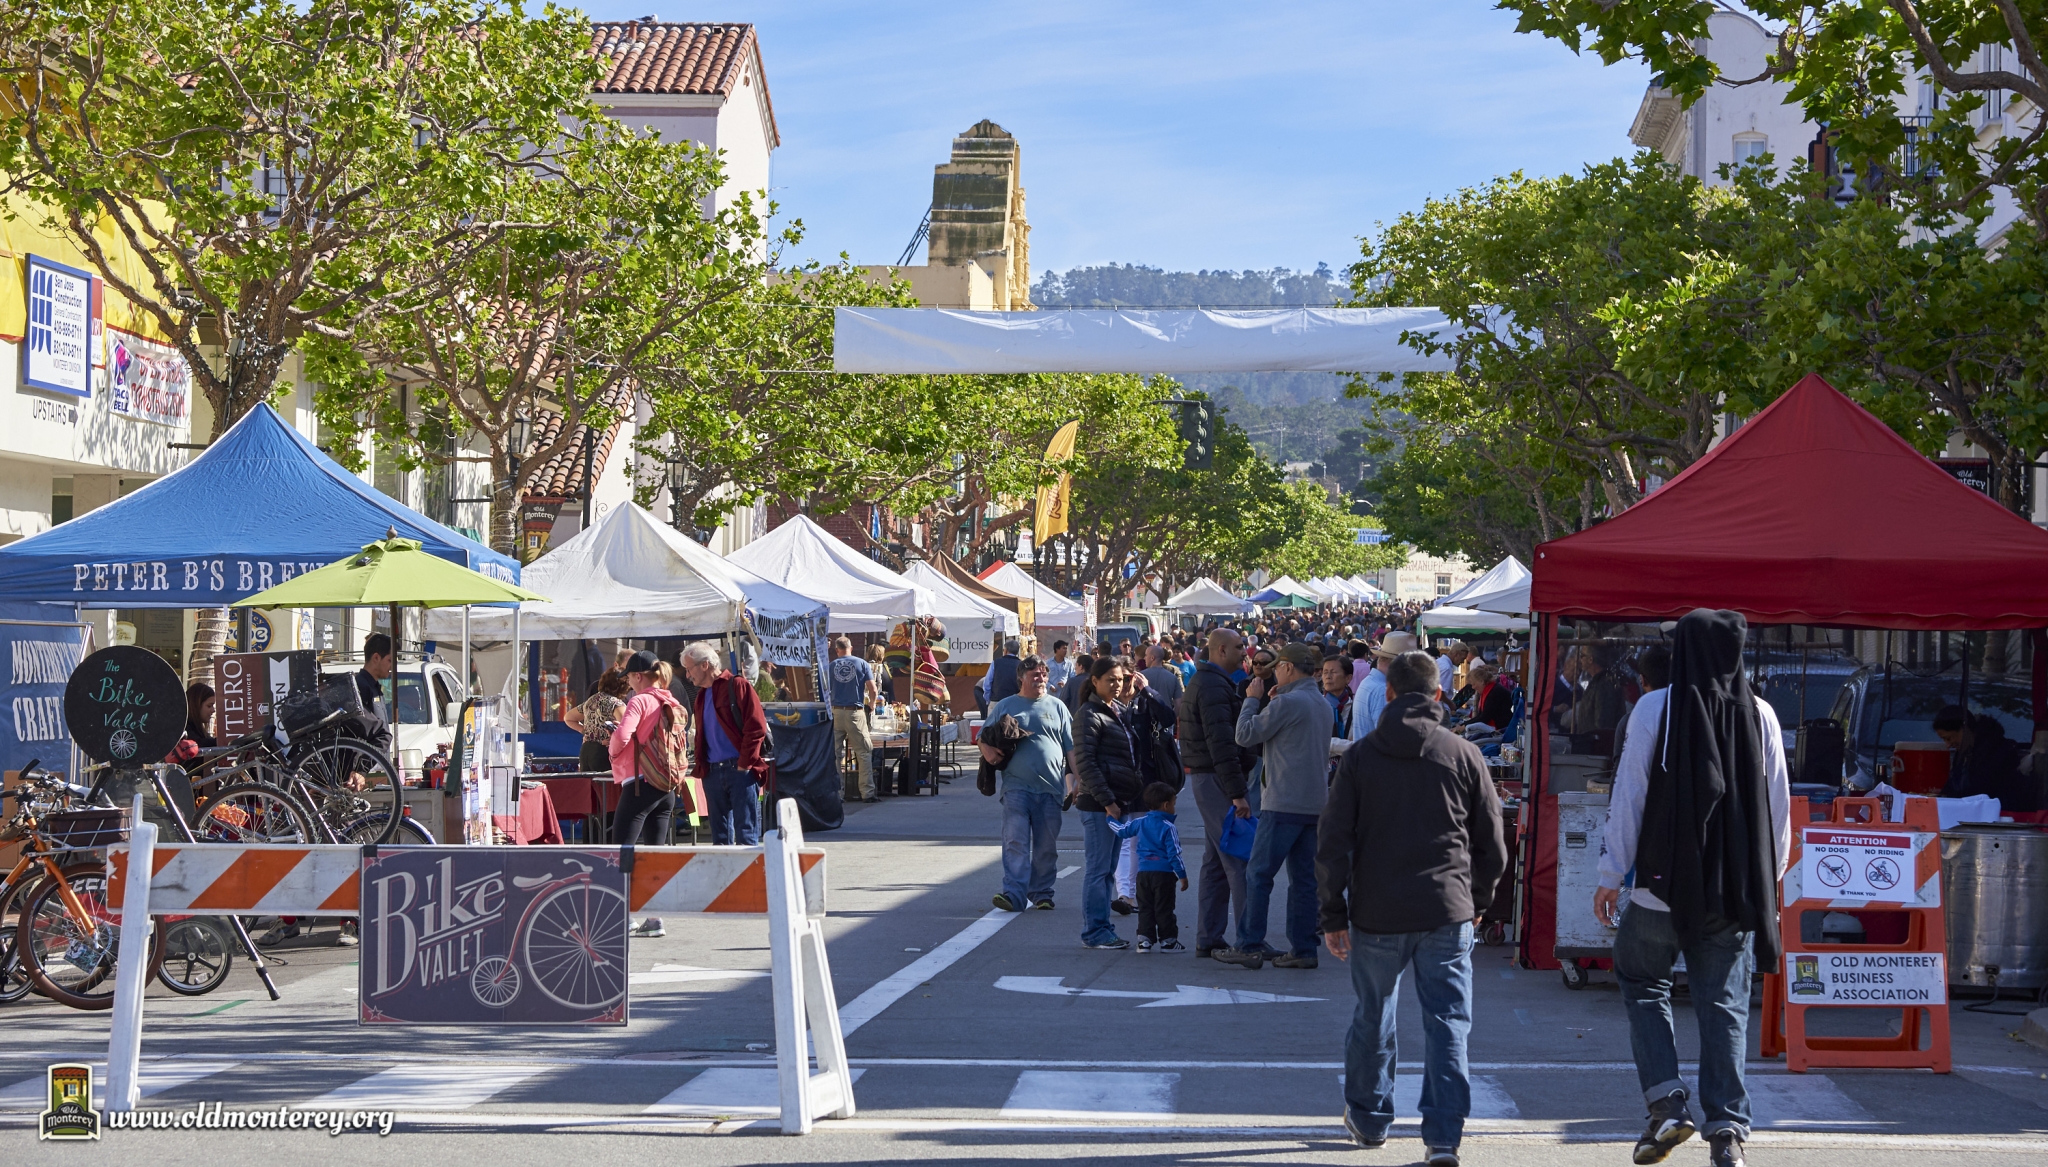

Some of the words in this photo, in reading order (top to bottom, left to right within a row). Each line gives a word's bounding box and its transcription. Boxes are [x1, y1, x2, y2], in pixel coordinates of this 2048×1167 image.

[54, 289, 82, 309] Construction
[113, 387, 130, 400] TACO
[130, 382, 186, 418] CONSTRUCTION
[32, 398, 67, 425] UPSTAIRS
[113, 401, 129, 413] BELL
[1956, 470, 1973, 478] Old
[524, 511, 555, 521] Monterey
[72, 561, 170, 592] PETER
[181, 560, 225, 592] B'S
[948, 637, 990, 654] ldpress
[104, 659, 120, 672] The
[88, 676, 151, 708] Bike
[12, 696, 64, 742] CRAFT
[104, 708, 150, 734] Valet
[1829, 835, 1887, 846] ATTENTION
[1828, 846, 1850, 854] DOGS
[370, 856, 507, 997] Bike
[418, 928, 485, 988] VALET
[1830, 956, 1859, 968] OLD
[1863, 956, 1937, 968] MONTEREY
[1831, 972, 1894, 984] BUSINESS
[1793, 982, 1823, 991] Monterey
[1832, 988, 1929, 1000] ASSOCIATION
